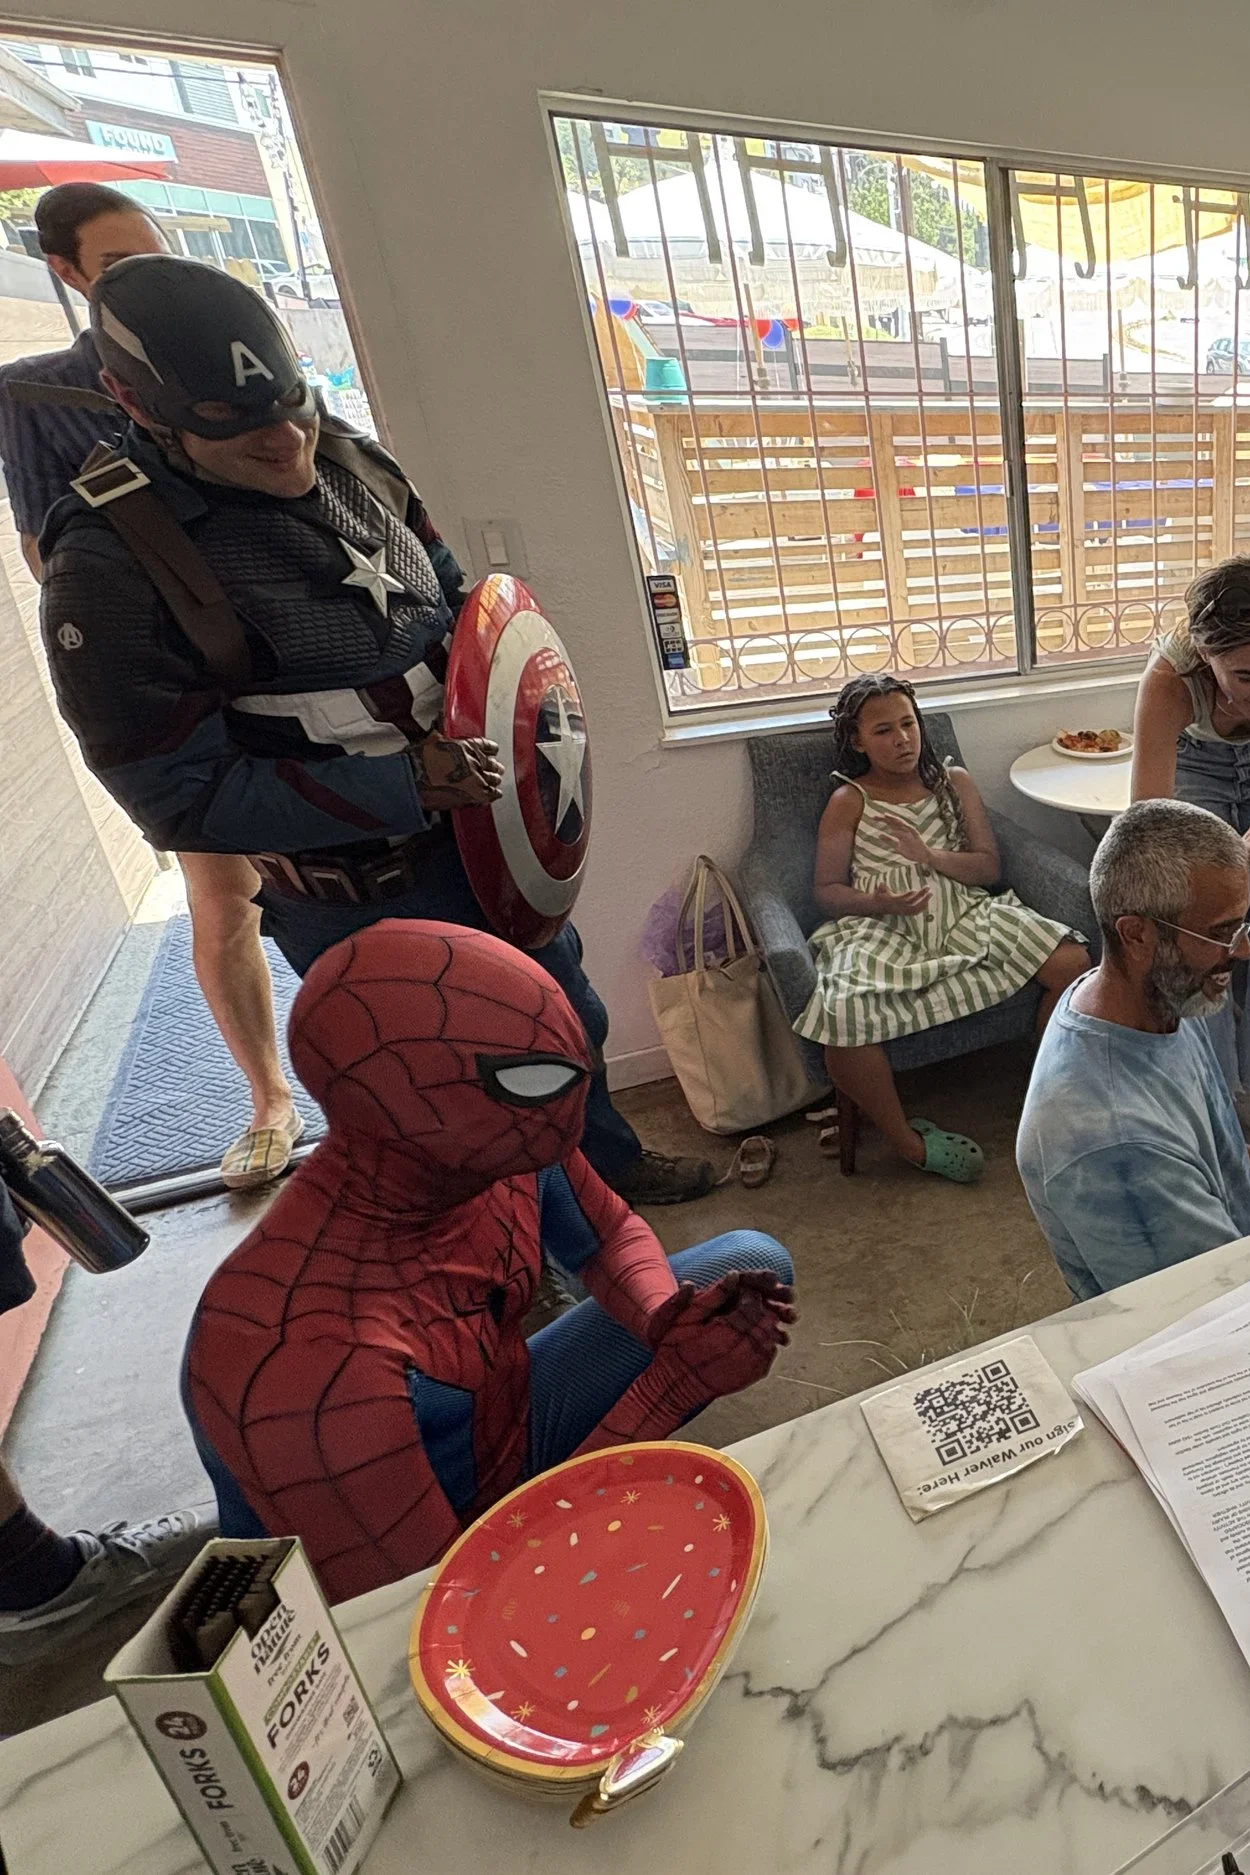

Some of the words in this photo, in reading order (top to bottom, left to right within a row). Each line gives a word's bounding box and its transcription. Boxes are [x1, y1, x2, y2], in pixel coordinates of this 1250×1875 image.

[100, 125, 165, 155] FOUND
[231, 341, 274, 386] A
[964, 1448, 1018, 1477] Waiver
[1019, 1438, 1044, 1453] our
[251, 1603, 289, 1659] open
[267, 1641, 330, 1750] FORKS
[179, 1747, 235, 1811] FORKS
